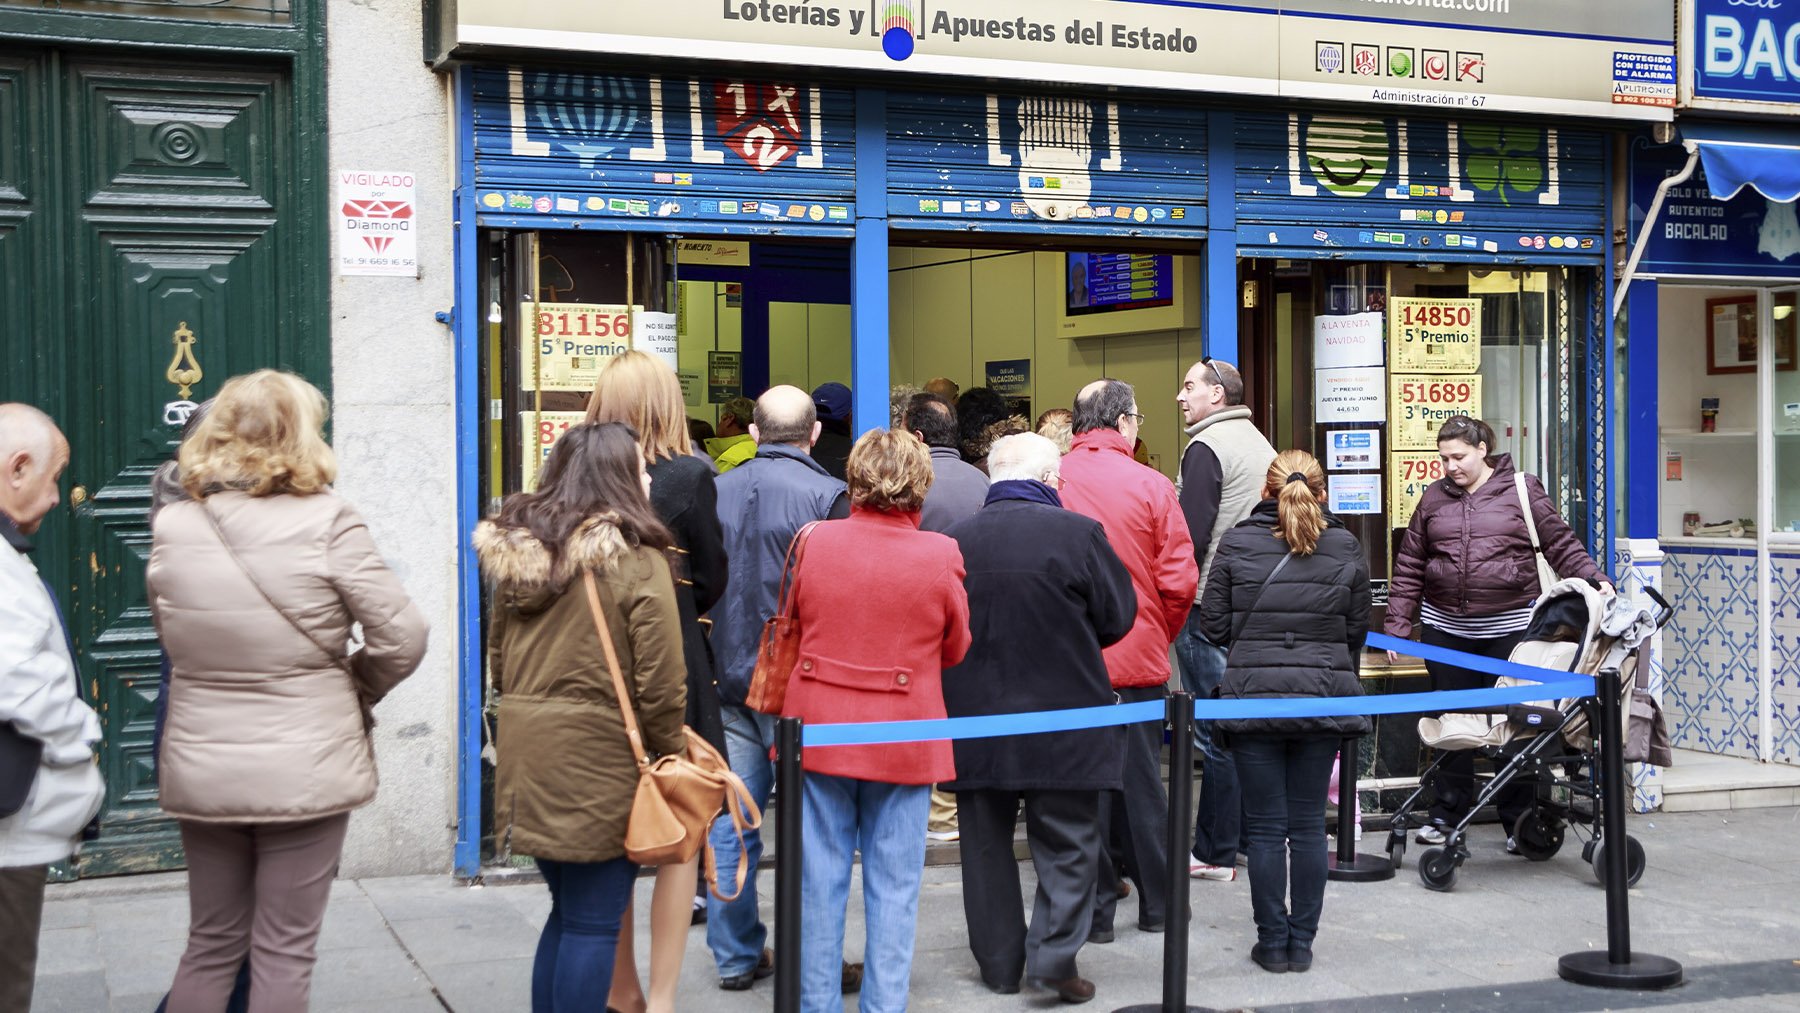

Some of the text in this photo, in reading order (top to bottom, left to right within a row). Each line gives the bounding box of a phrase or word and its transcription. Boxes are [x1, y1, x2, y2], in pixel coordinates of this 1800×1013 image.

[723, 0, 865, 36] Loterías y
[931, 10, 1198, 54] Apuestas del Estado
[1615, 53, 1672, 64] PROTEGIDO
[1615, 61, 1673, 72] CON SISTEMA
[1615, 69, 1673, 80] DE ALARMA
[1614, 82, 1673, 95] APLITRONIC
[1372, 89, 1454, 105] Administración
[1471, 96, 1486, 107] 67
[341, 174, 414, 188] VIGILADO
[1665, 187, 1691, 198] SOLO
[1668, 205, 1724, 217] AUTENTICO
[1665, 222, 1728, 241] BACALAO
[370, 257, 388, 265] 669
[402, 258, 415, 266] 56
[1402, 306, 1471, 327] 14850
[537, 312, 629, 338] 81156
[1321, 319, 1371, 330] A LA VENTA
[1326, 336, 1366, 345] NAVIDAD
[1420, 330, 1469, 343] Premio
[563, 341, 627, 357] Premio
[1402, 383, 1471, 403] 51689
[1421, 406, 1469, 419] Premio
[1402, 460, 1447, 481] 798
